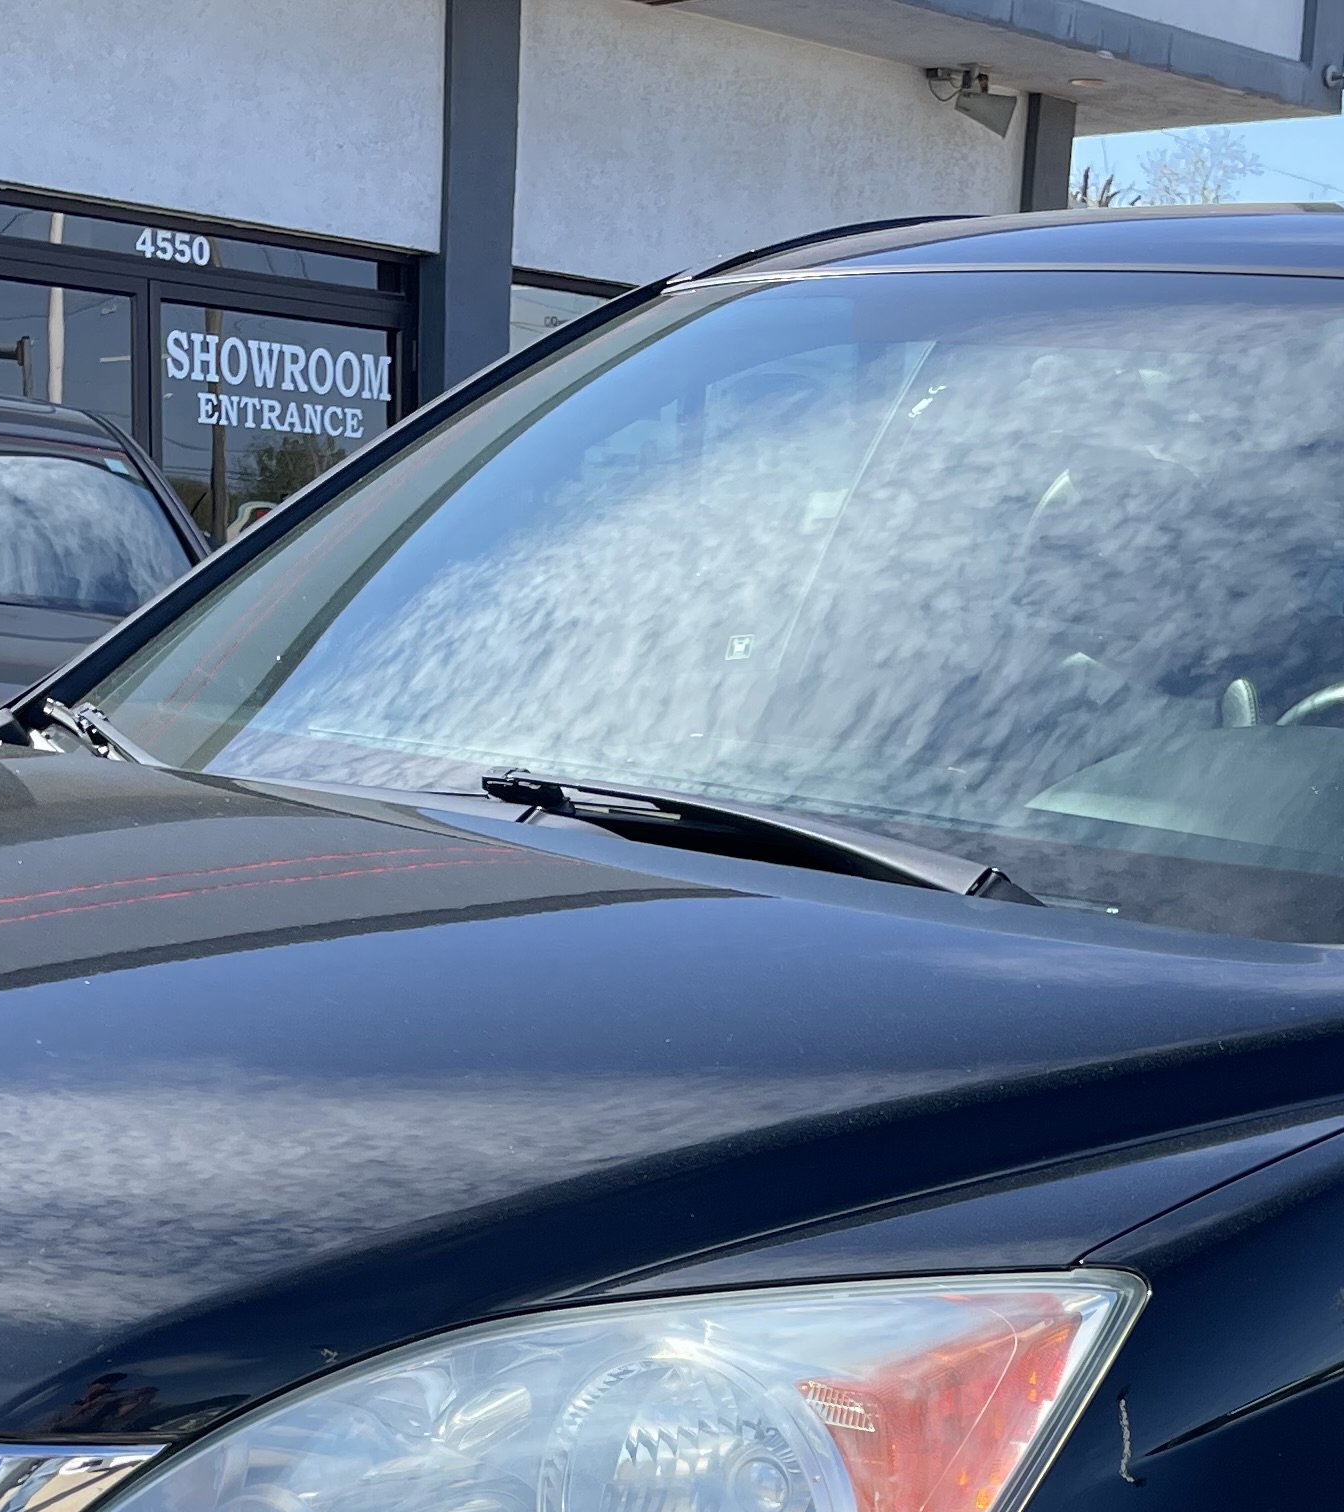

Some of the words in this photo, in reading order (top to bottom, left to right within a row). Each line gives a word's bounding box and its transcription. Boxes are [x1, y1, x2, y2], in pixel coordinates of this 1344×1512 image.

[135, 227, 211, 267] 4550
[166, 329, 393, 402] SHOWROOM
[197, 392, 365, 439] ENTRANCE
